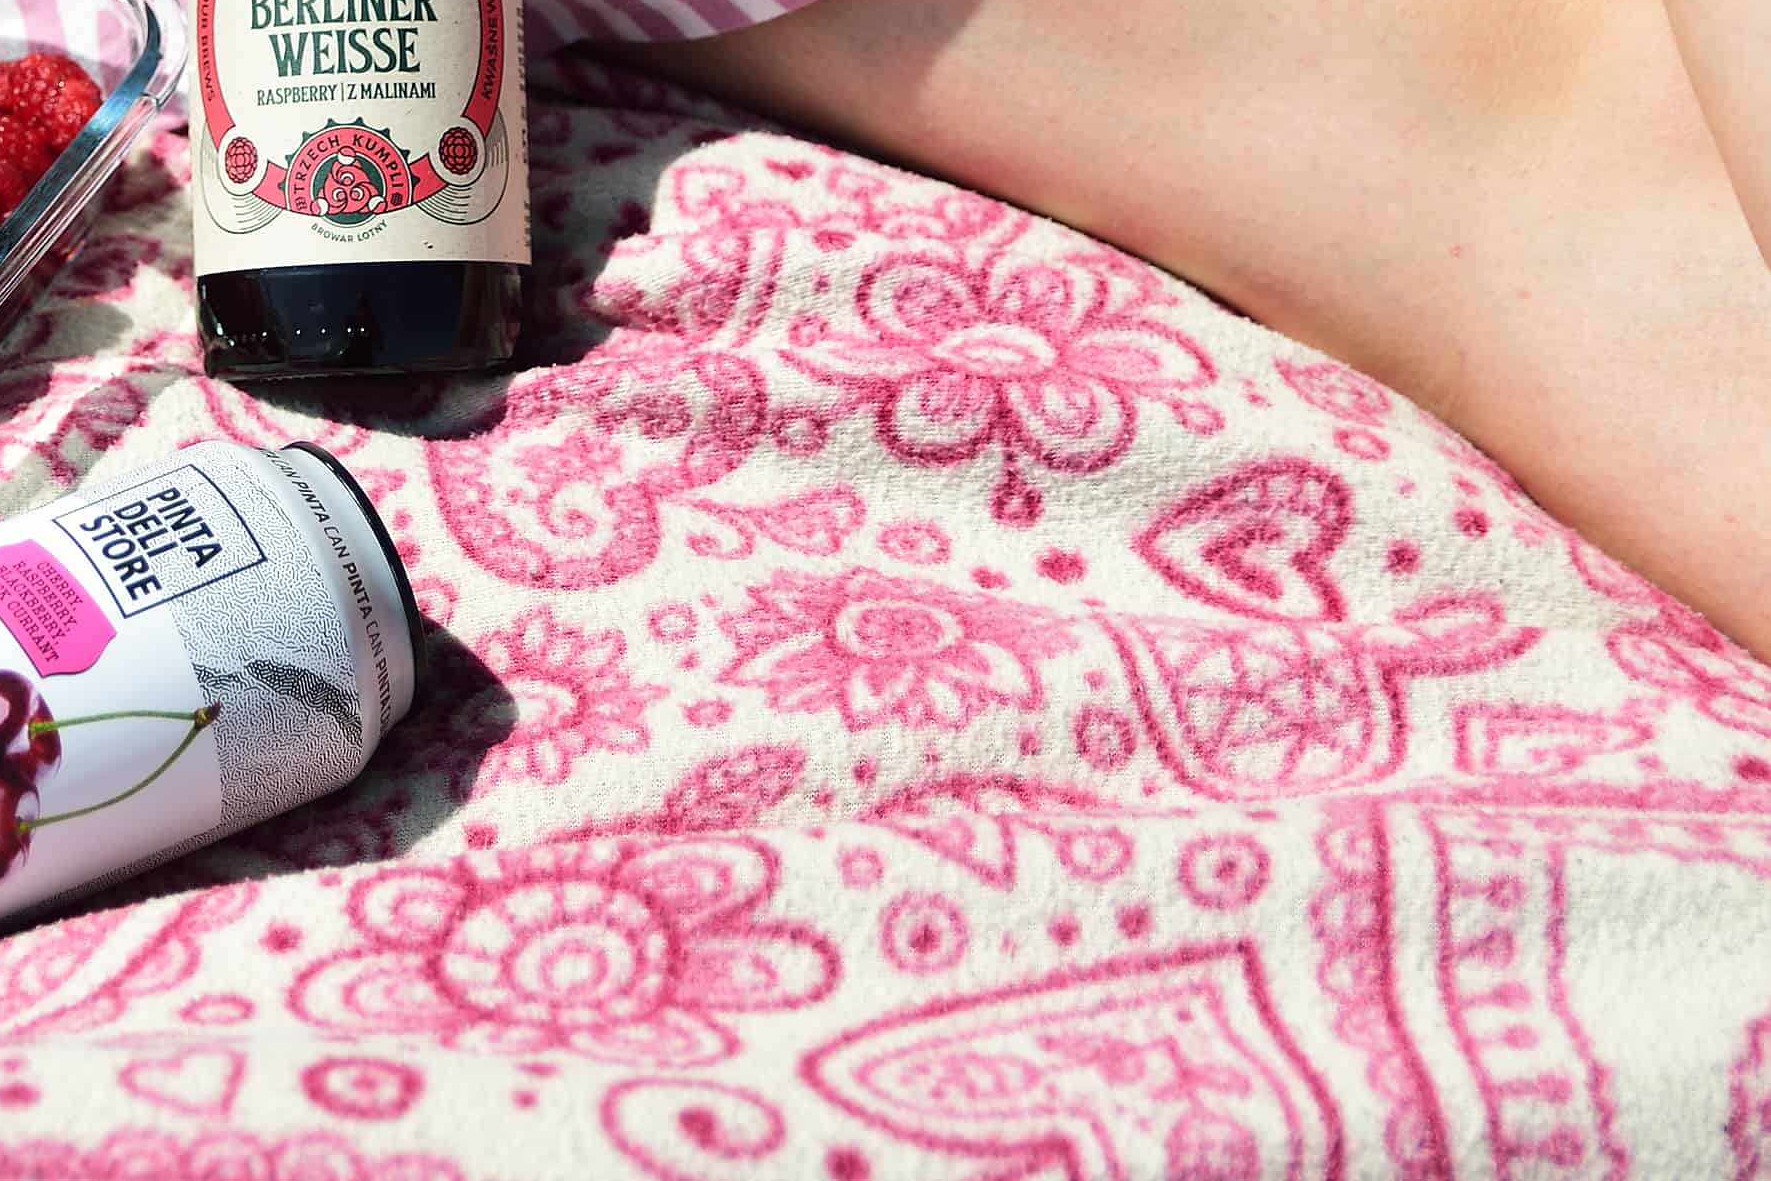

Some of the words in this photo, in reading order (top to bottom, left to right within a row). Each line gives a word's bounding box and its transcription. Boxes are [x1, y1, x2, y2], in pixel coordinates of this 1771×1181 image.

[268, 27, 421, 77] WEISSE
[257, 84, 338, 107] RASPBERRY
[347, 83, 358, 100] Z
[360, 82, 436, 100] MALINAMI
[294, 134, 340, 193] TRZECH
[353, 134, 404, 189] KUMPLI
[311, 222, 354, 243] BROWAR
[356, 219, 388, 242] LOTNY
[79, 514, 162, 600] STORE
[113, 500, 178, 558] DELI
[147, 487, 223, 568] PINTA
[291, 481, 330, 523] PINTA
[323, 526, 350, 559] CAN
[342, 562, 373, 618] PINTA
[366, 620, 383, 658] CAN
[8, 600, 59, 662] CURRANT
